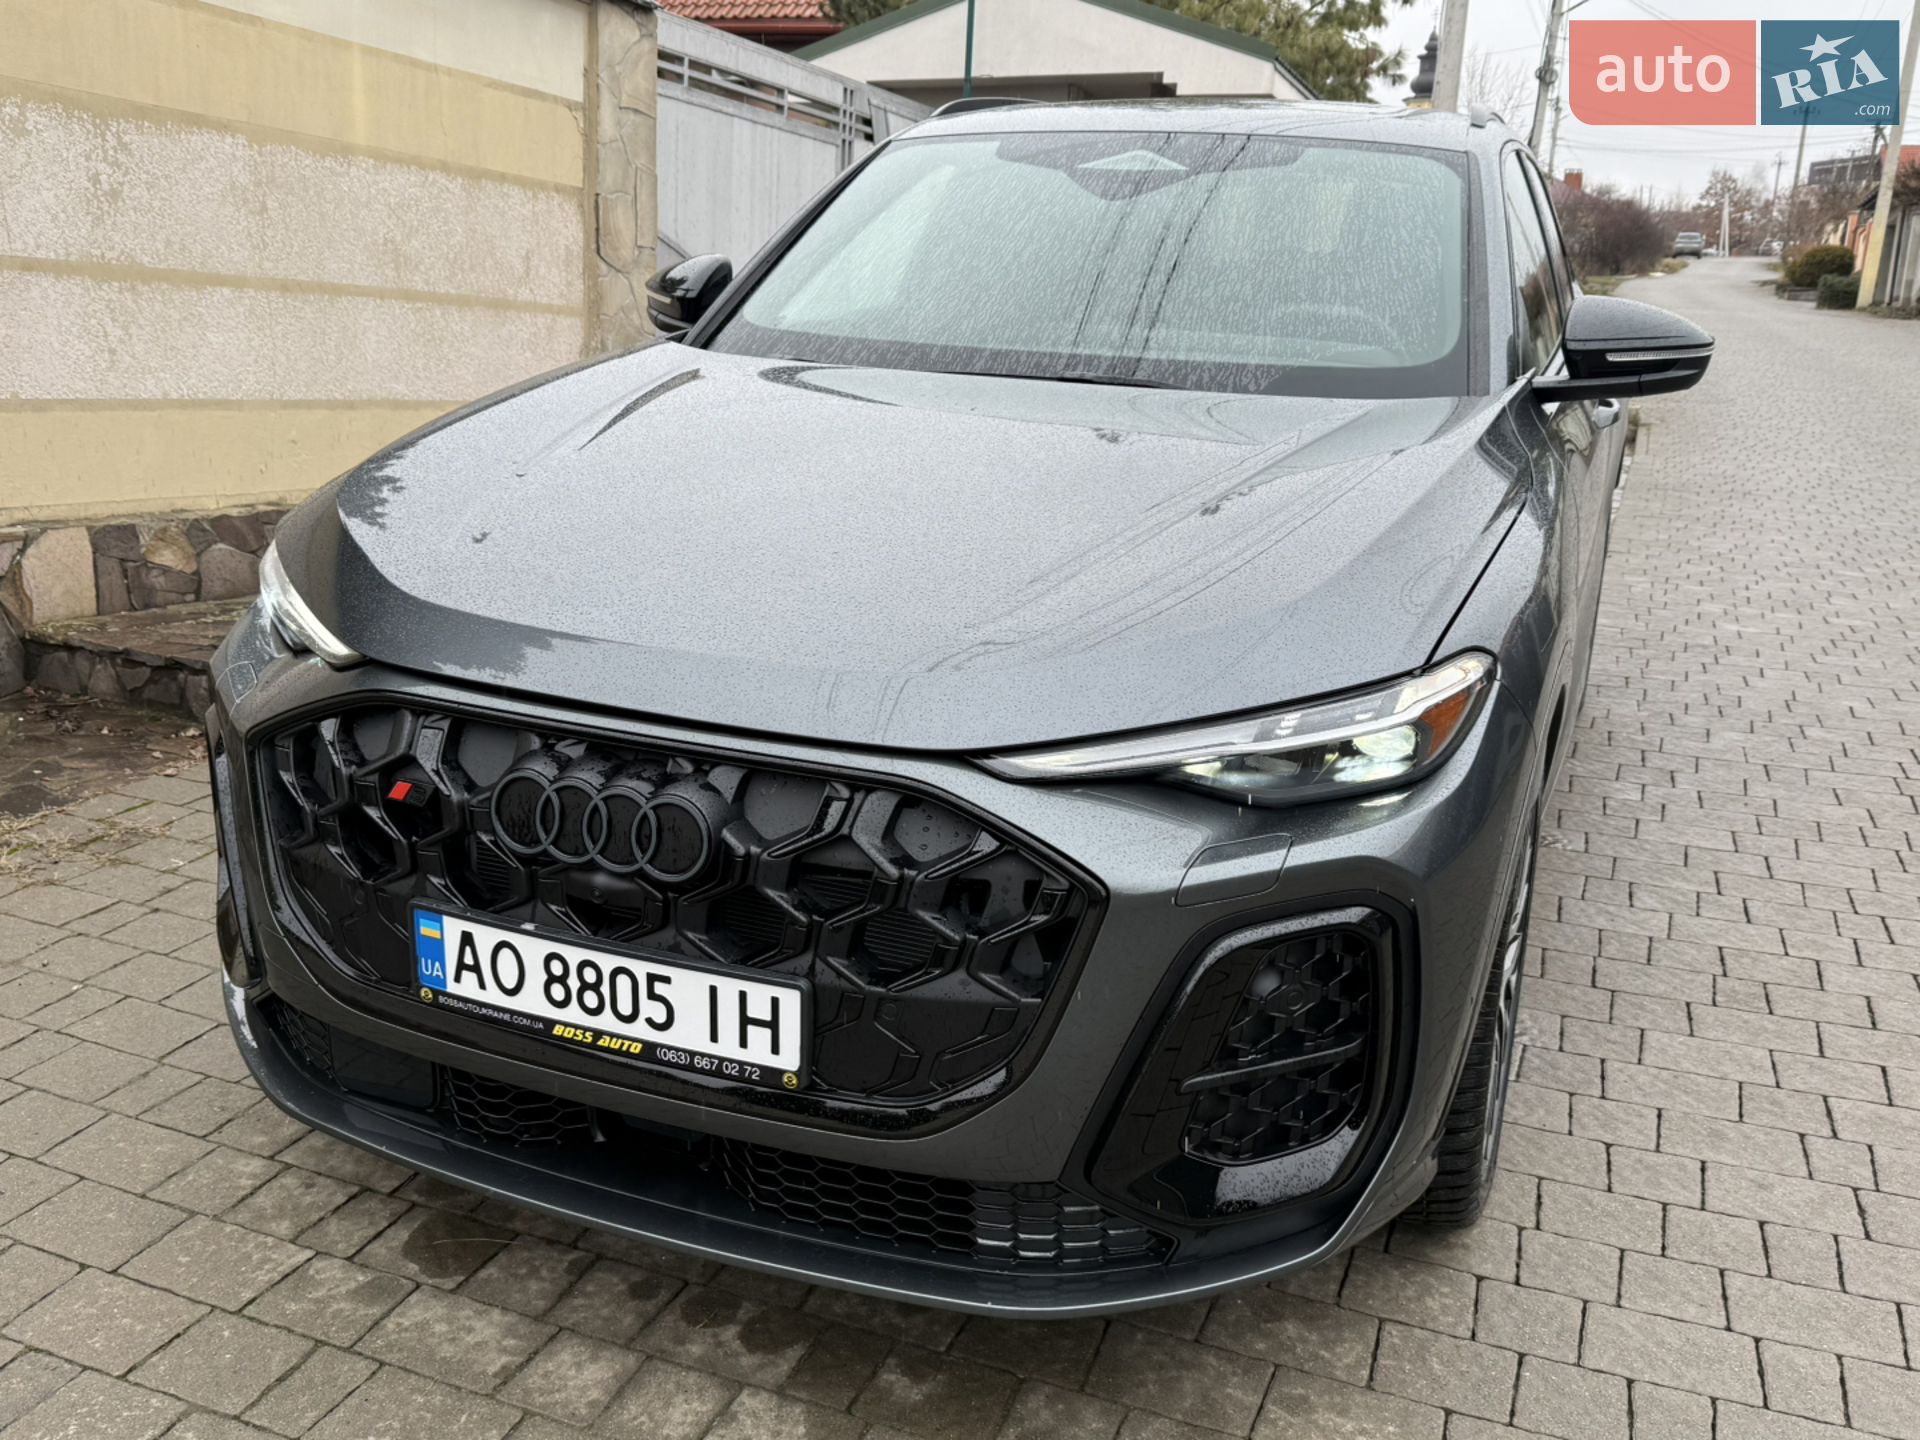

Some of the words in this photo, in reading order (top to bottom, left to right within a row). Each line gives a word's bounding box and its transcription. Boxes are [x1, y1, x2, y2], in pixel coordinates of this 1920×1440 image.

[421, 957, 444, 979] UA
[453, 930, 526, 997] AO
[542, 951, 675, 1032] 8805
[708, 984, 780, 1056] IH
[552, 1023, 593, 1043] BOSS
[596, 1034, 643, 1055] AUTO
[656, 1047, 690, 1066] (063)
[694, 1055, 718, 1071] 667
[722, 1061, 740, 1077] 02
[743, 1066, 761, 1081] 72
